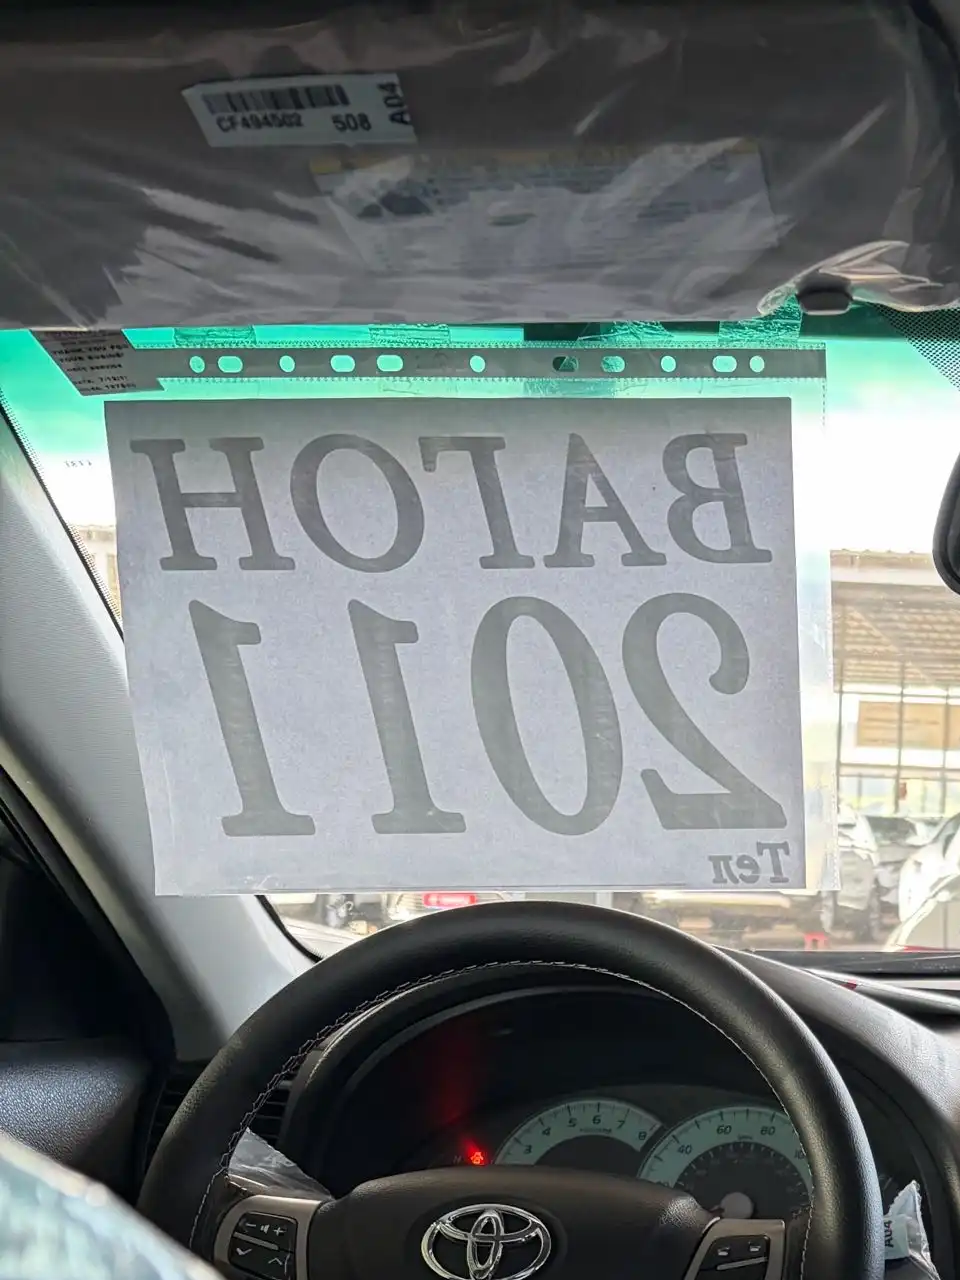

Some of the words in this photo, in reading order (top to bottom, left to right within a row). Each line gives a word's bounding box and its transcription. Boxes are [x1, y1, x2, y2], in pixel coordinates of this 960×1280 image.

[377, 81, 411, 126] A04
[331, 113, 372, 132] 508
[567, 1118, 577, 1128] 5
[592, 1115, 601, 1124] 6
[616, 1120, 626, 1129] 7
[542, 1127, 551, 1136] 4
[716, 1125, 732, 1135] 60
[760, 1126, 776, 1136] 80
[638, 1131, 647, 1141] 8
[523, 1145, 532, 1154] 3
[678, 1144, 692, 1155] 40
